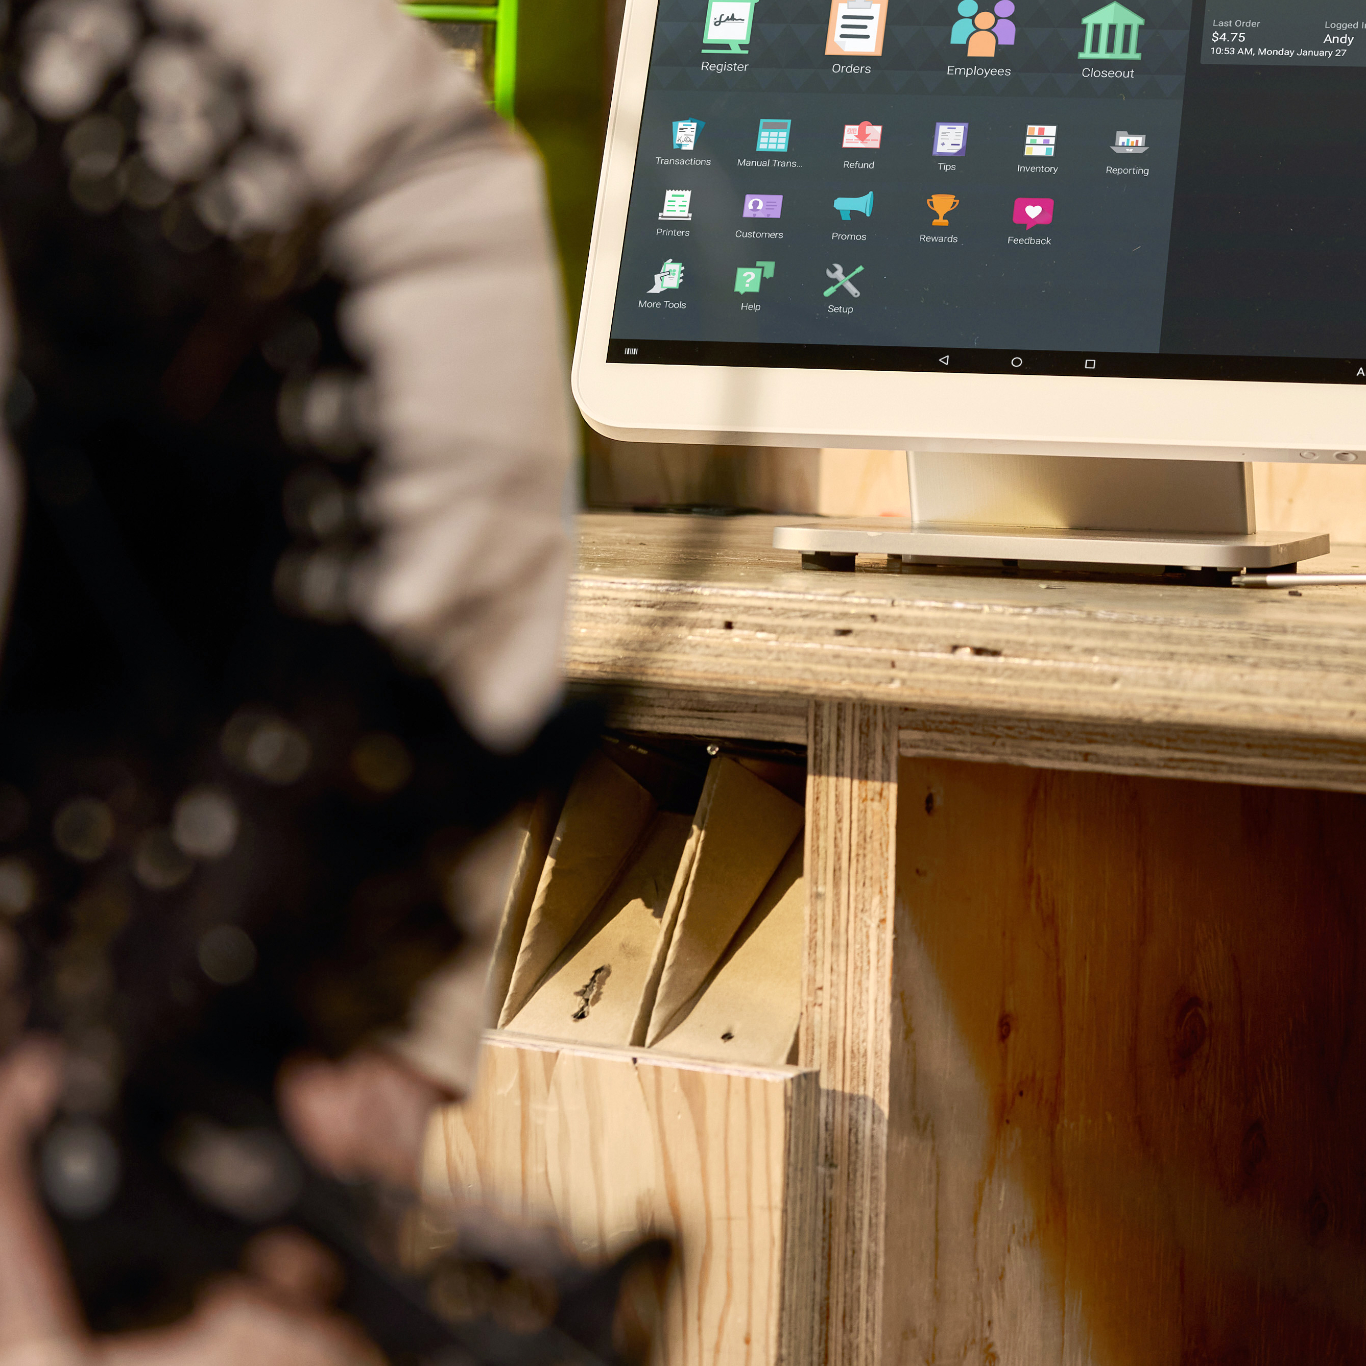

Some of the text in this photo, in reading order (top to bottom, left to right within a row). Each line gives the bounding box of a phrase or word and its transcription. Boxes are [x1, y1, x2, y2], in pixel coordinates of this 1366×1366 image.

[1213, 19, 1261, 28] Last Order
[1325, 20, 1359, 31] Logged
[1212, 30, 1246, 43] $4.75
[1323, 33, 1355, 47] Andy
[1211, 46, 1347, 59] 10:53 AM, Monday January 27
[702, 61, 750, 74] Register
[832, 63, 872, 74] Orders
[947, 65, 1012, 79] Employees
[1082, 67, 1135, 79] Closeout
[656, 156, 712, 166] Transactions
[738, 158, 803, 168] Manual Trans...
[844, 160, 875, 170] Refund
[938, 162, 956, 172] Tips
[1018, 164, 1059, 175] Inventory
[1106, 165, 1150, 177] Reporting
[657, 228, 690, 237] Printers
[736, 229, 784, 239] Customers
[832, 232, 867, 241] Promos
[920, 234, 959, 243] Rewards
[1008, 236, 1052, 245] Feedback
[639, 300, 687, 309] More Tools
[741, 302, 761, 313] Help
[828, 304, 854, 315] Setup
